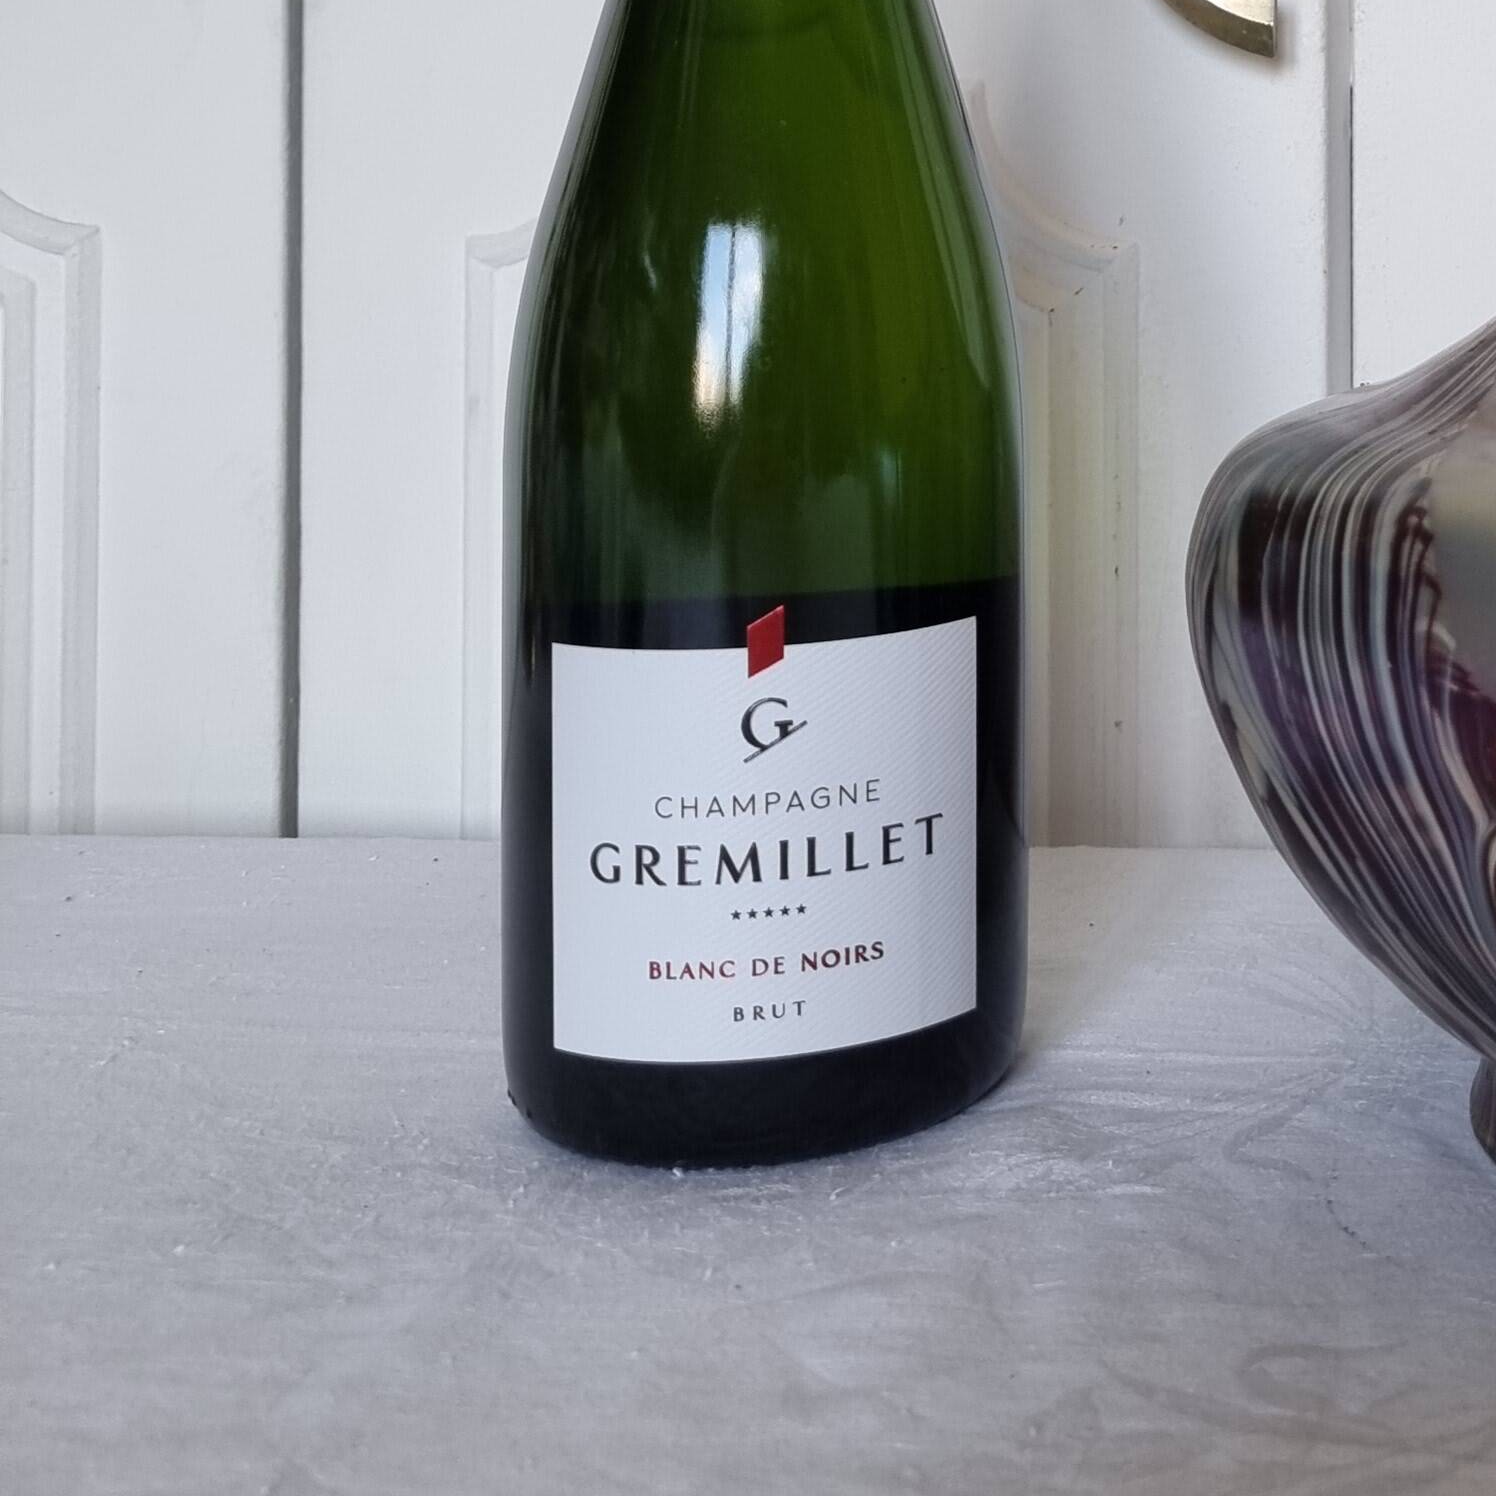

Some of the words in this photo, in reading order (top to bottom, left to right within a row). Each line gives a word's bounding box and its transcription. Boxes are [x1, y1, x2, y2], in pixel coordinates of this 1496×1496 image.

[654, 778, 881, 819] CHAMPAGNE
[589, 812, 944, 887] GREMILLET
[648, 959, 736, 981] BLANC
[751, 956, 786, 978] DE
[801, 940, 885, 972] NOIRS
[733, 1000, 808, 1022] BRUT
